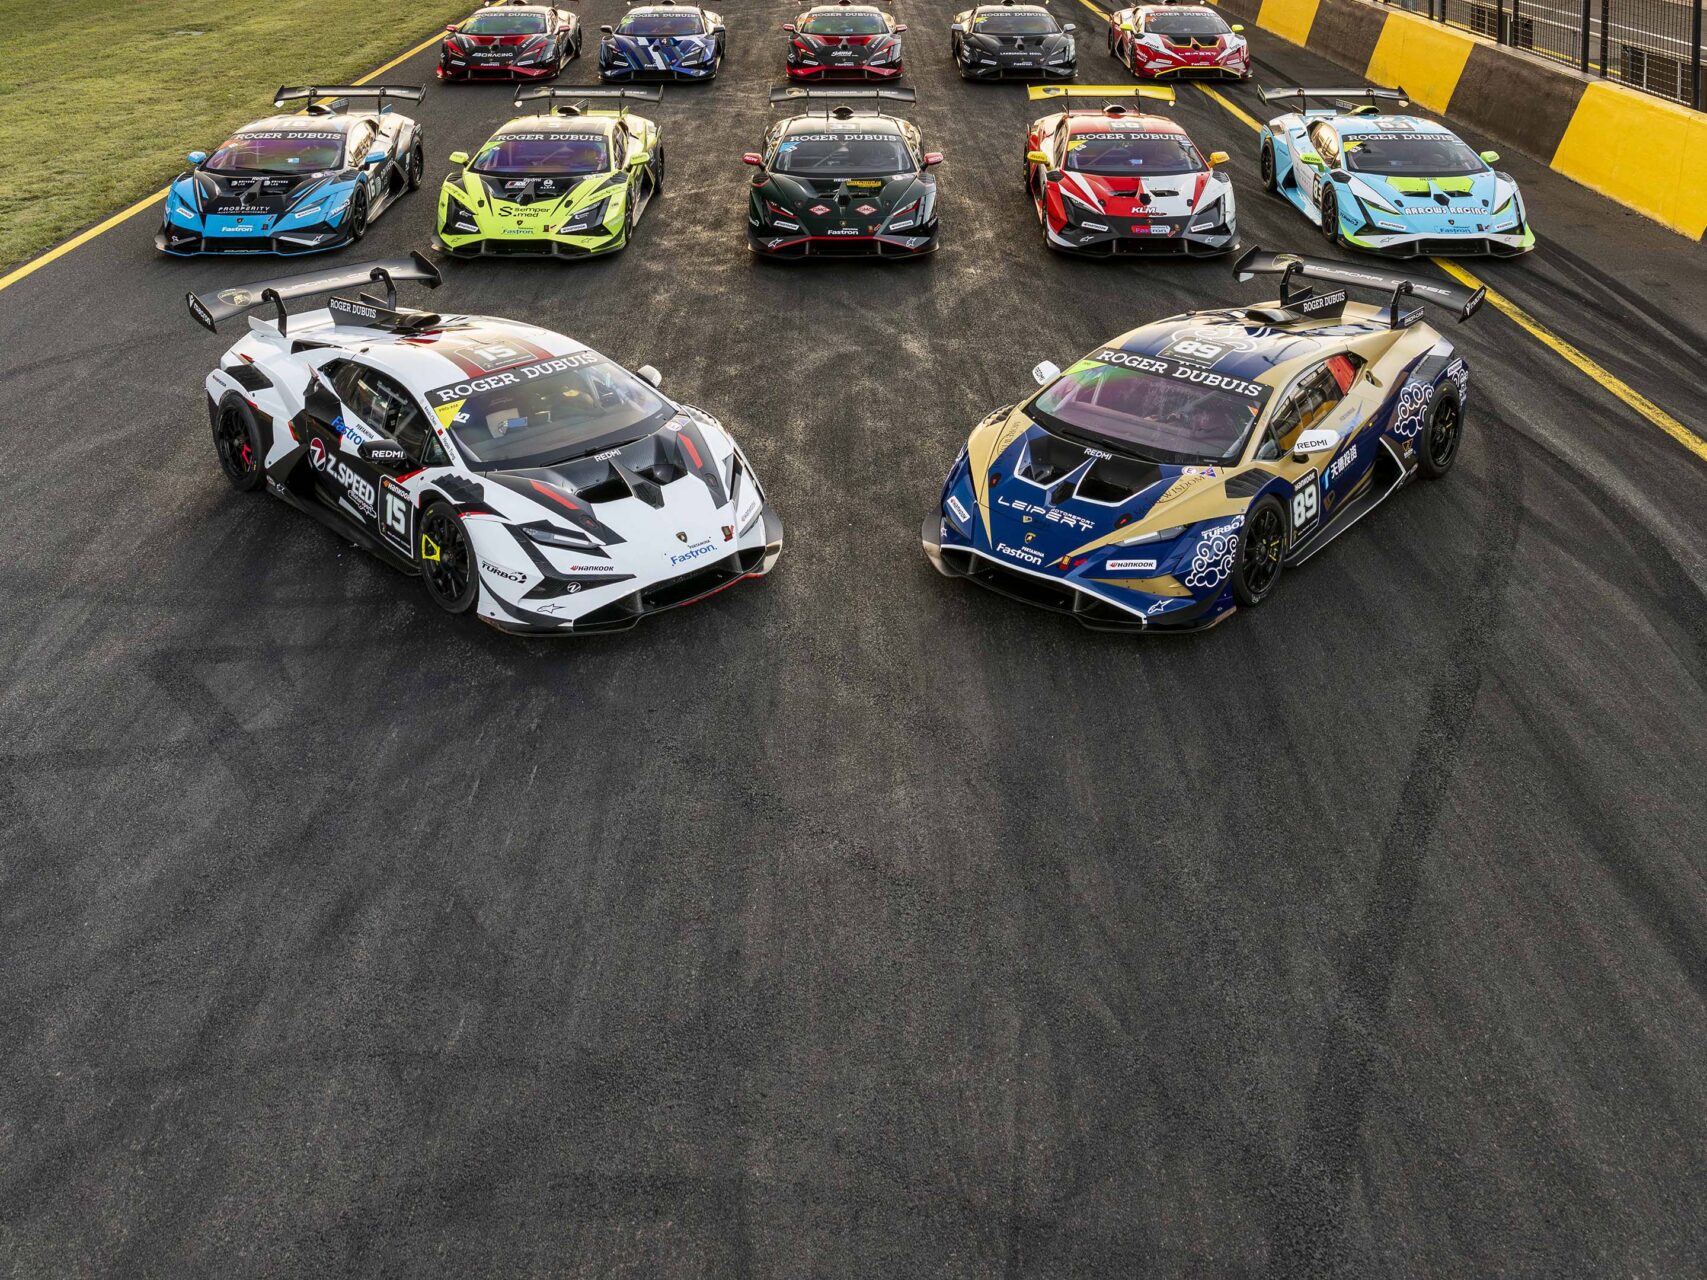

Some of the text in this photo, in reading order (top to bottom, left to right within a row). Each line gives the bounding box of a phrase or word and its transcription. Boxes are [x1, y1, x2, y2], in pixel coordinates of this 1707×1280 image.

[287, 132, 341, 140] DUBUIS
[1130, 133, 1184, 141] DUBUIS
[1404, 207, 1489, 215] ARROWS RACING
[1391, 279, 1452, 296] CRSE
[330, 298, 377, 319] ROGER DUBUIS
[1303, 291, 1345, 313] ROGER DUBUIS
[474, 345, 518, 361] 15
[436, 353, 598, 402] ROGER DUBUIS
[1096, 350, 1168, 374] ROGER
[1172, 367, 1263, 396] DUBUIS
[371, 450, 404, 459] REDMI
[1084, 447, 1112, 461] REDMI
[1296, 439, 1328, 450] REDMI
[594, 448, 622, 462] REDMI
[326, 453, 375, 505] Z.SPEED
[386, 493, 406, 534] 15
[997, 496, 1093, 532] LEIPERT
[1293, 483, 1317, 528] 89
[1202, 521, 1240, 540] TURBO
[670, 545, 716, 566] Fastron
[996, 542, 1042, 566] Fastron
[481, 562, 519, 582] TURBO
